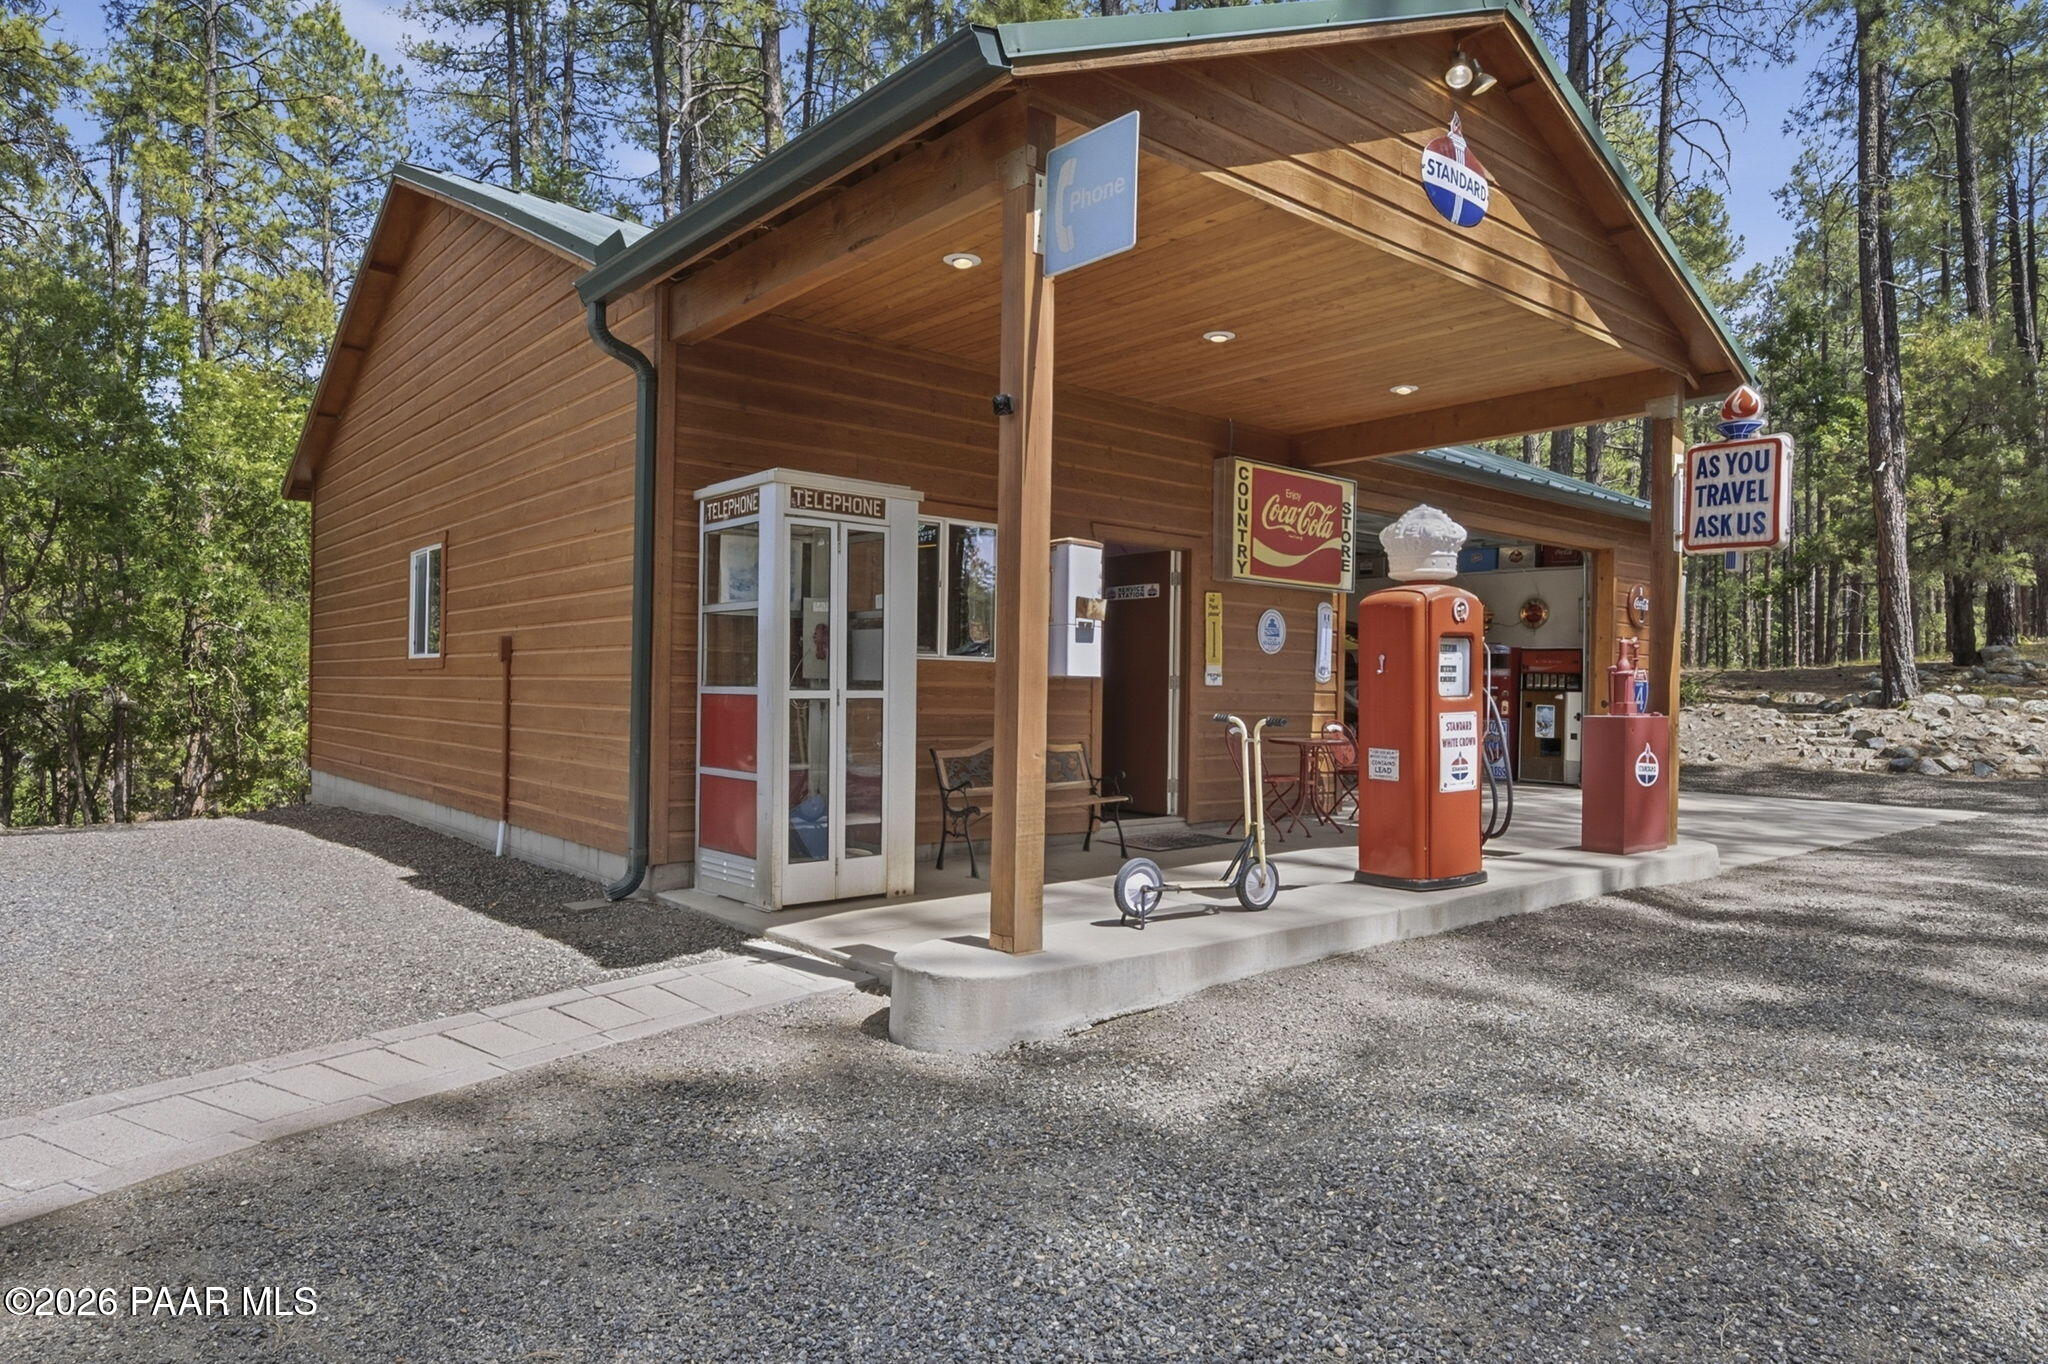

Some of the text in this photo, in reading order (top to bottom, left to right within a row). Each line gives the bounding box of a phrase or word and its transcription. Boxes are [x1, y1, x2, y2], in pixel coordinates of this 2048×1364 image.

[1070, 176, 1126, 213] Phone
[1426, 158, 1486, 202] STANDARD
[1695, 449, 1770, 480] AS YOU
[706, 491, 759, 521] TELEPHONE
[793, 488, 882, 517] TELEPHONE
[1285, 488, 1301, 502] Enjoy
[1695, 479, 1769, 508] TRAVEL
[1236, 466, 1249, 574] COUNTRY
[1261, 494, 1337, 539] Coca-Cola
[1694, 511, 1766, 539] ASK US
[1341, 501, 1352, 573] STORE
[1636, 686, 1645, 710] 4
[1446, 720, 1472, 731] STANDARD
[1442, 737, 1476, 748] WHITE CROWN
[1374, 766, 1392, 774] LEAD
